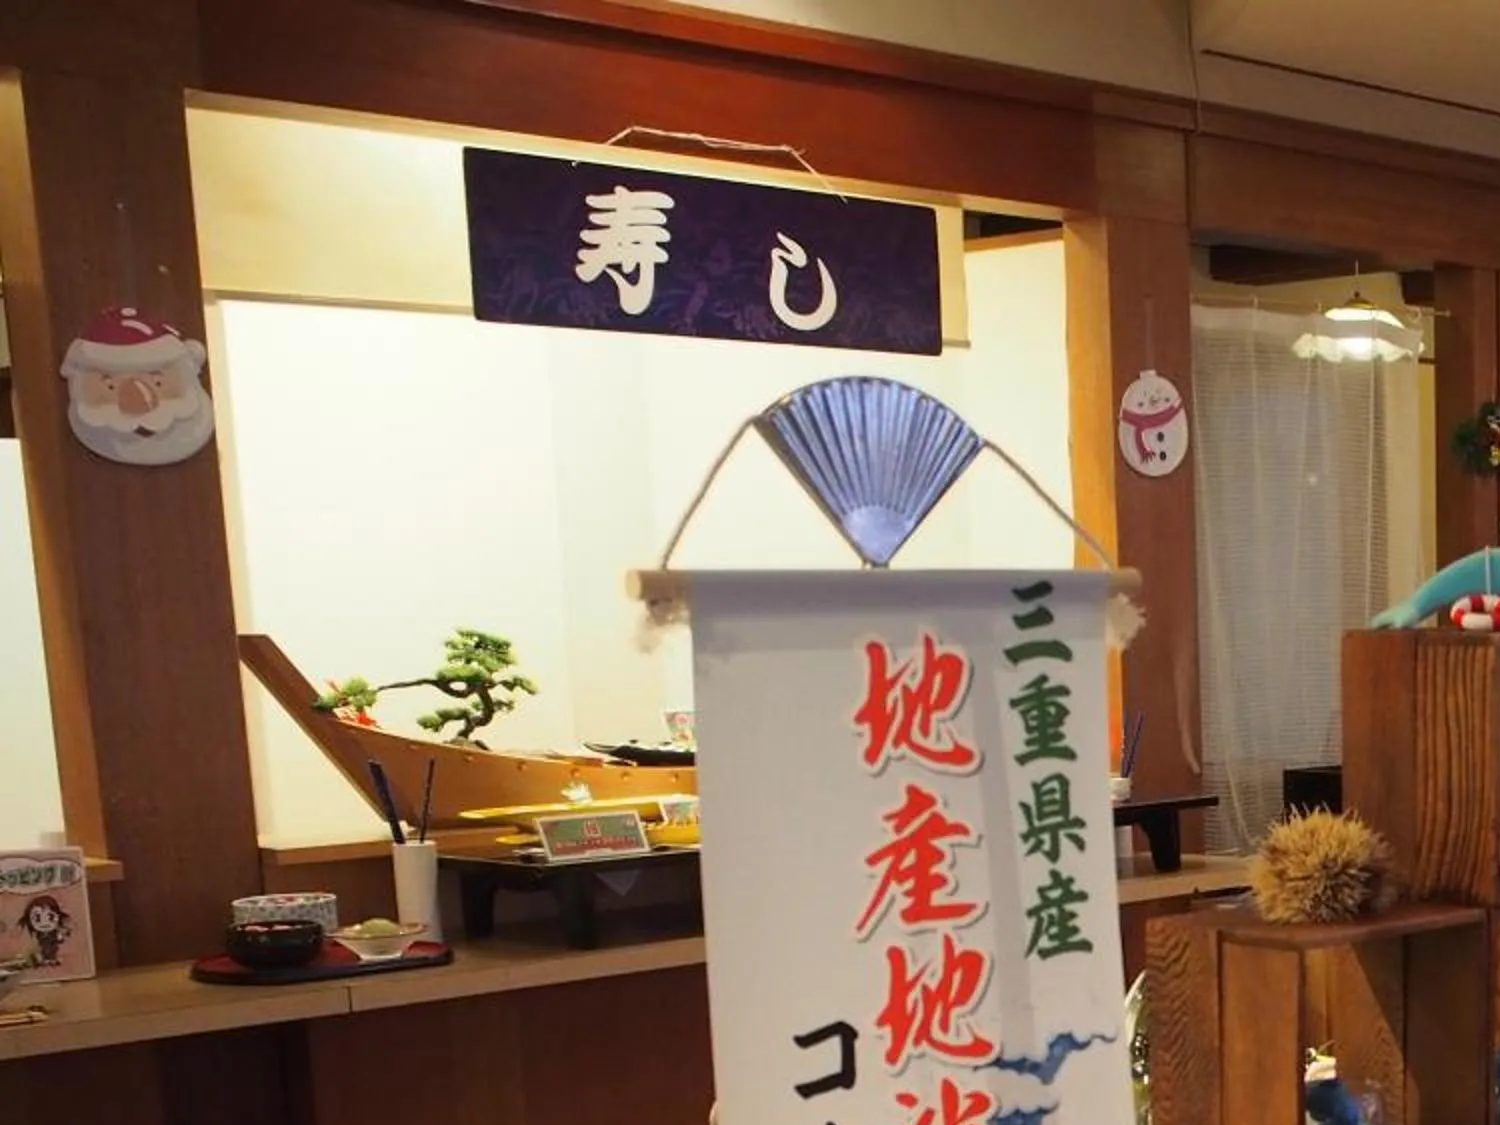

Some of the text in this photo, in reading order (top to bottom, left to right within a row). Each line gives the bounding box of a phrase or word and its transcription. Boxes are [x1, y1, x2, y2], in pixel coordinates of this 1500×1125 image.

[575, 185, 838, 332] 寿し
[1001, 578, 1094, 958] 三重県産
